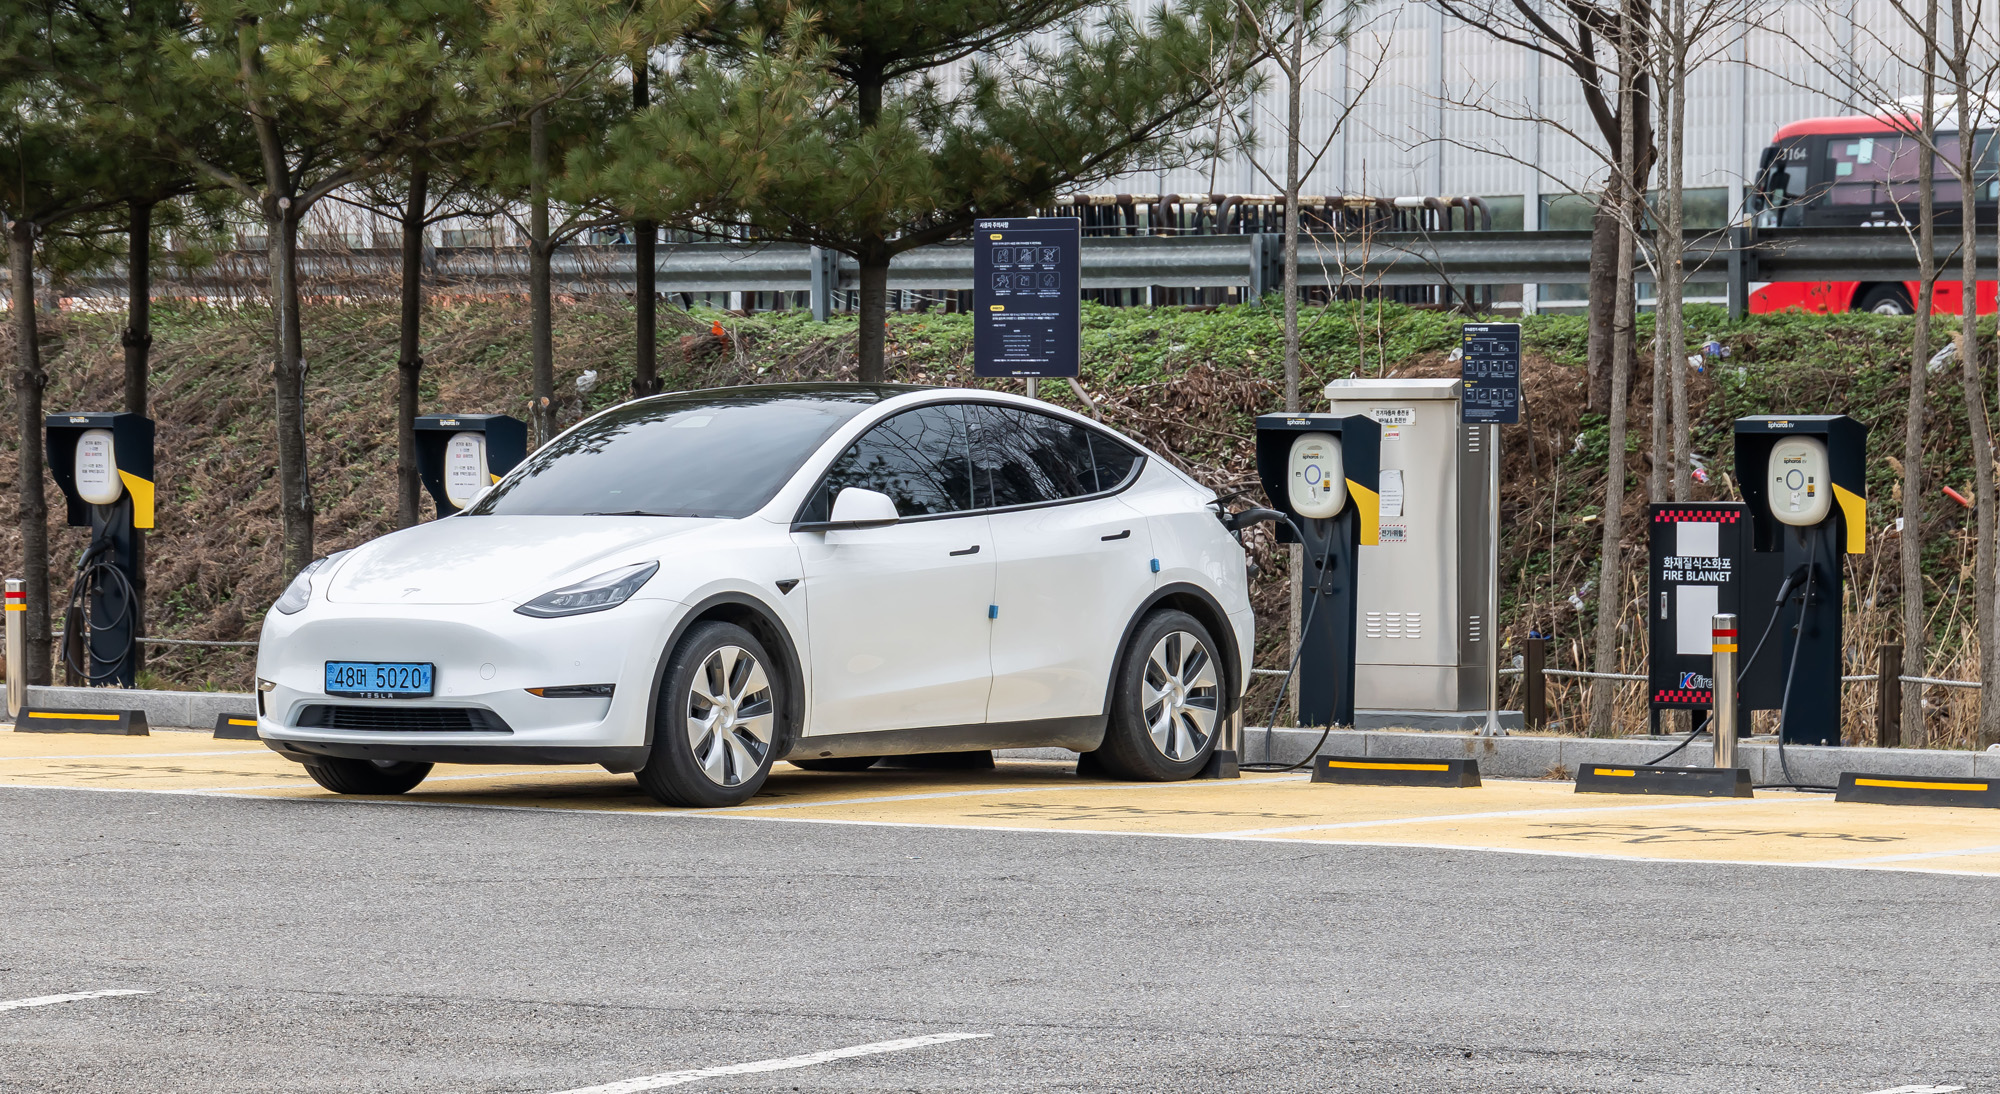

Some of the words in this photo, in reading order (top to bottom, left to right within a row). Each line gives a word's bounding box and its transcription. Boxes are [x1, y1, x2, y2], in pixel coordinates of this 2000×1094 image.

[1375, 409, 1396, 417] 전기자동차
[1286, 418, 1305, 426] spharos
[1767, 421, 1788, 429] spharos
[1381, 529, 1391, 537] 전기
[1393, 529, 1403, 537] 위험
[1663, 556, 1732, 570] 화재질식소화포
[1663, 570, 1684, 581] FIRE
[1686, 570, 1732, 582] BLANKET
[334, 666, 367, 687] 48머
[376, 667, 421, 688] 5020
